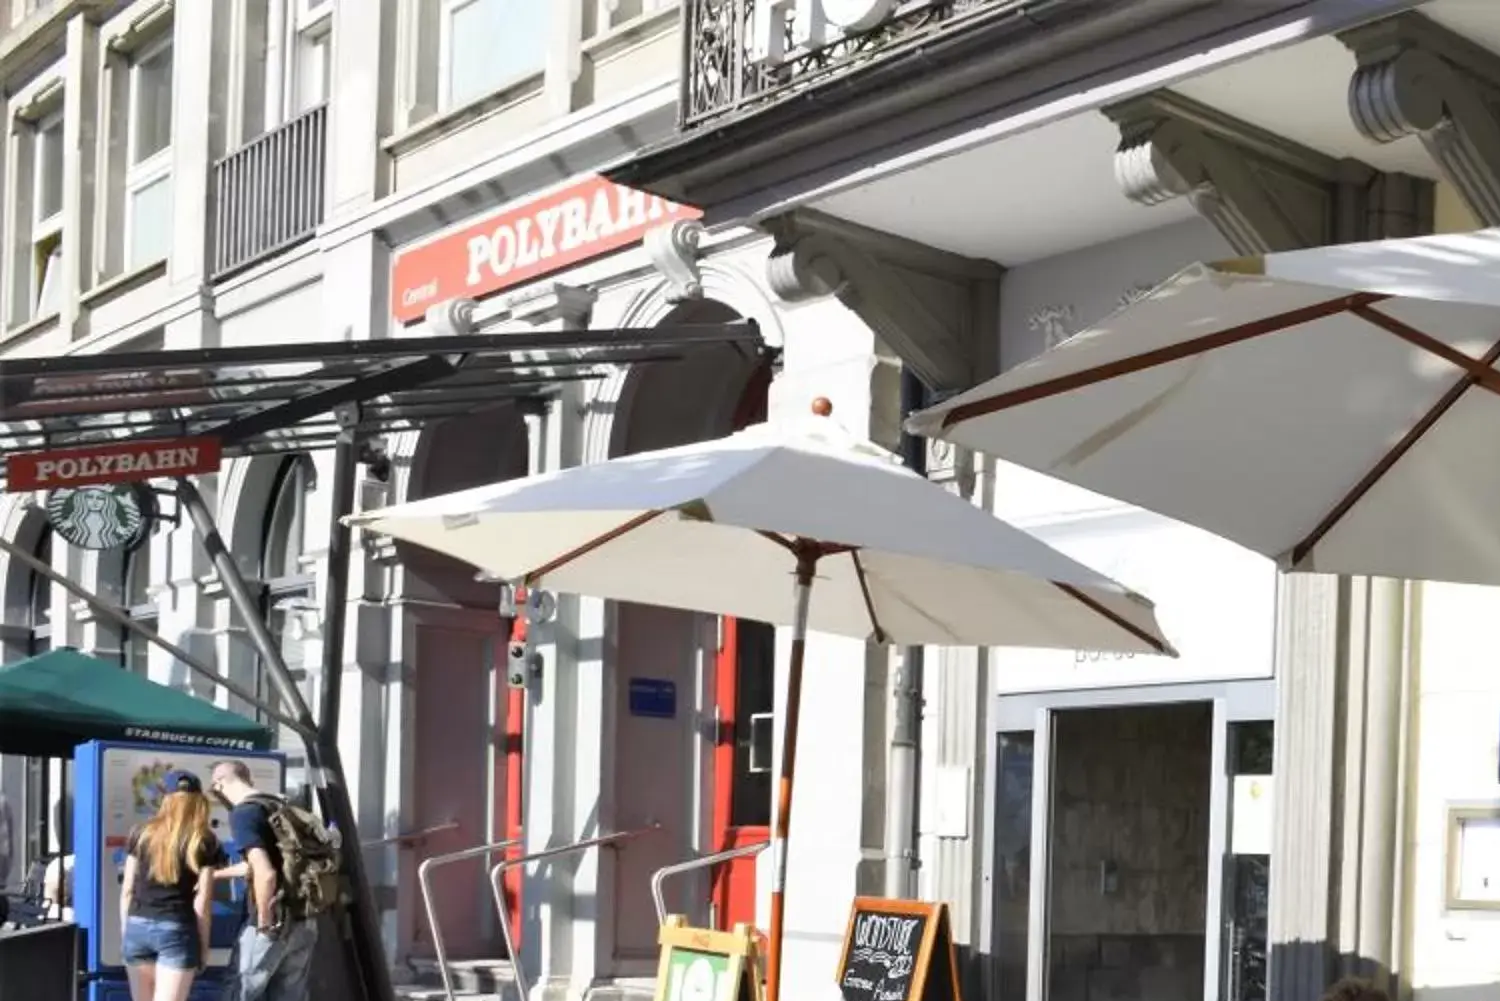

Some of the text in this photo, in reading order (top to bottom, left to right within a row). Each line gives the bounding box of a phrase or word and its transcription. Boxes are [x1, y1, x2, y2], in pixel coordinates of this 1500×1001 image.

[35, 448, 199, 481] POLYBAHN
[125, 727, 255, 751] STARBUCKS COFFEE
